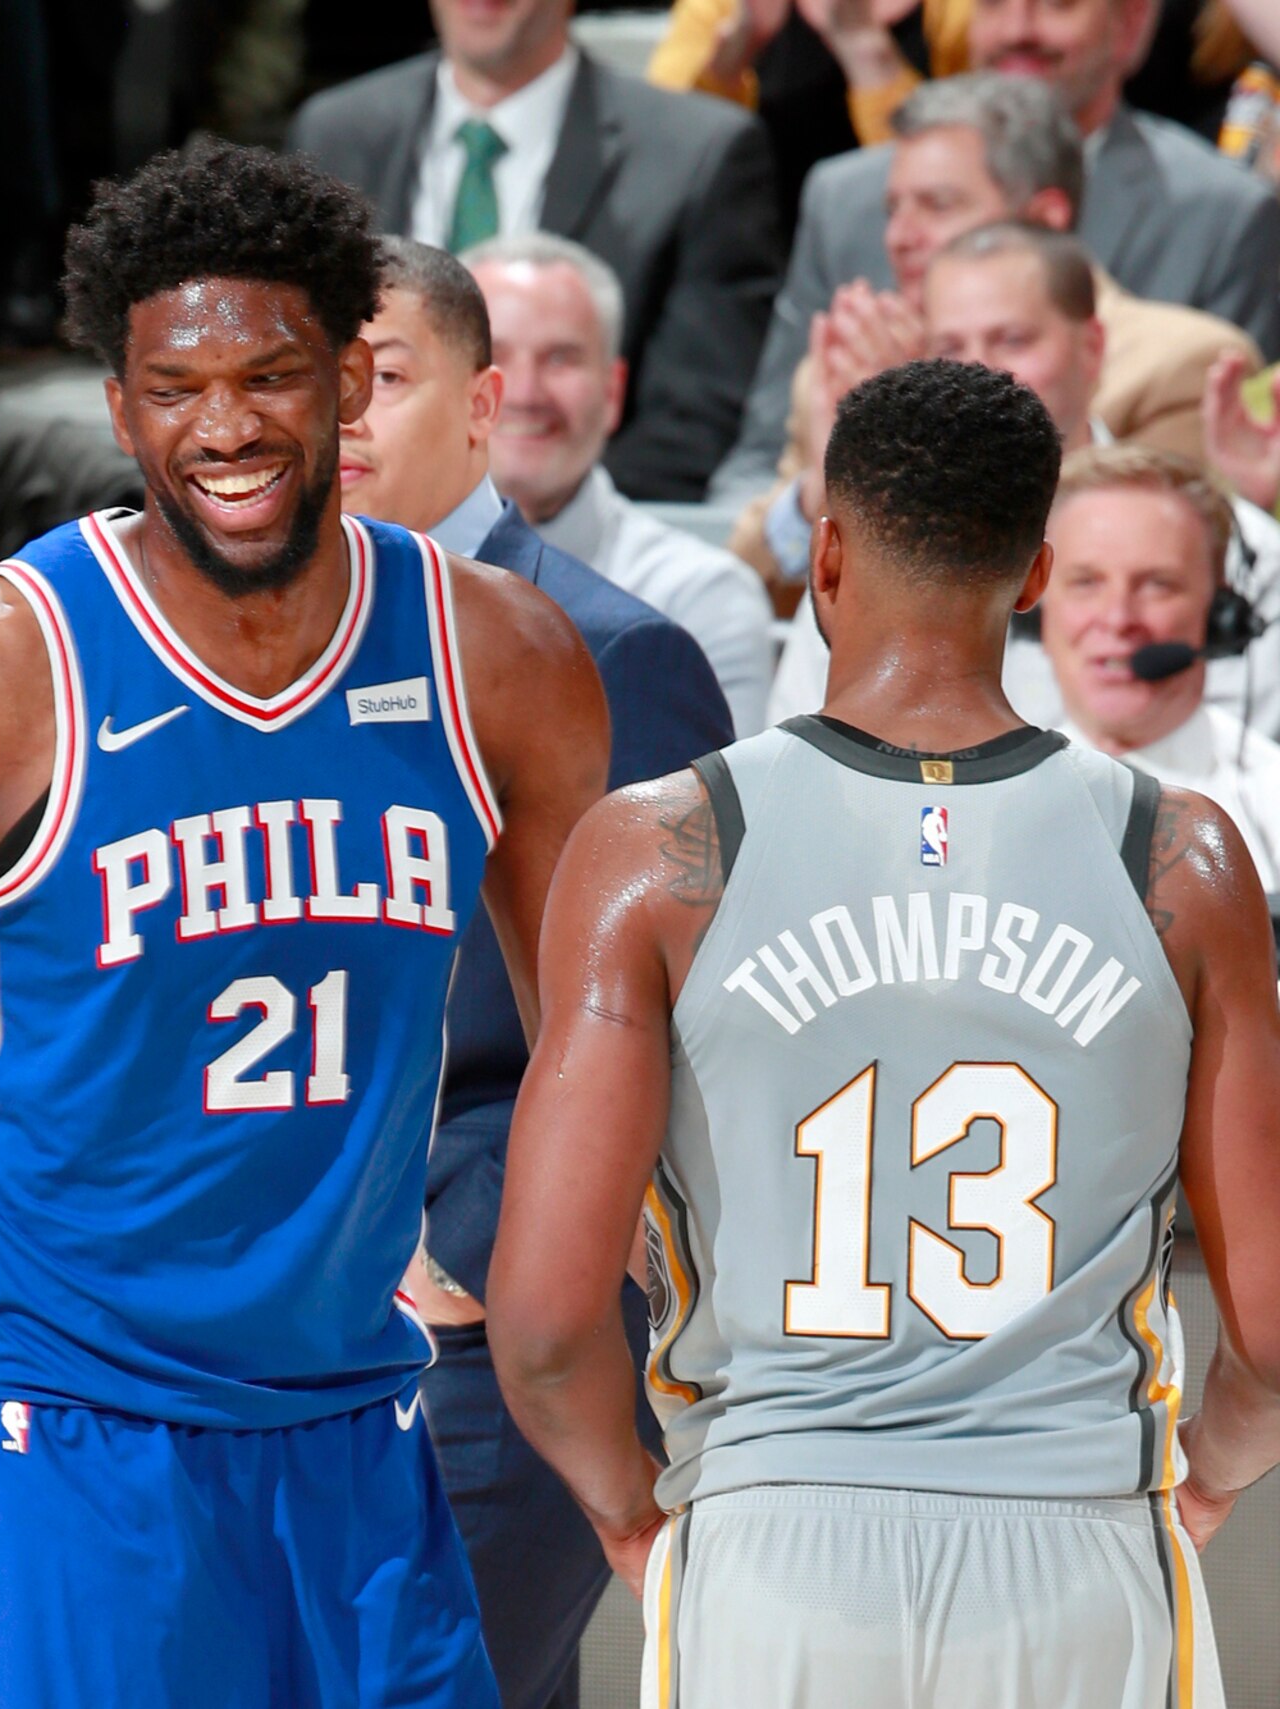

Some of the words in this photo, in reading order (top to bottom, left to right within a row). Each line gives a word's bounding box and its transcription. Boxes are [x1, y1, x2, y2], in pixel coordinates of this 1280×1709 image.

[357, 694, 417, 714] StubHub
[91, 798, 456, 970] PHILA
[203, 969, 351, 1115] 21
[722, 891, 1143, 1048] THOMPSON
[783, 1058, 1059, 1341] 13
